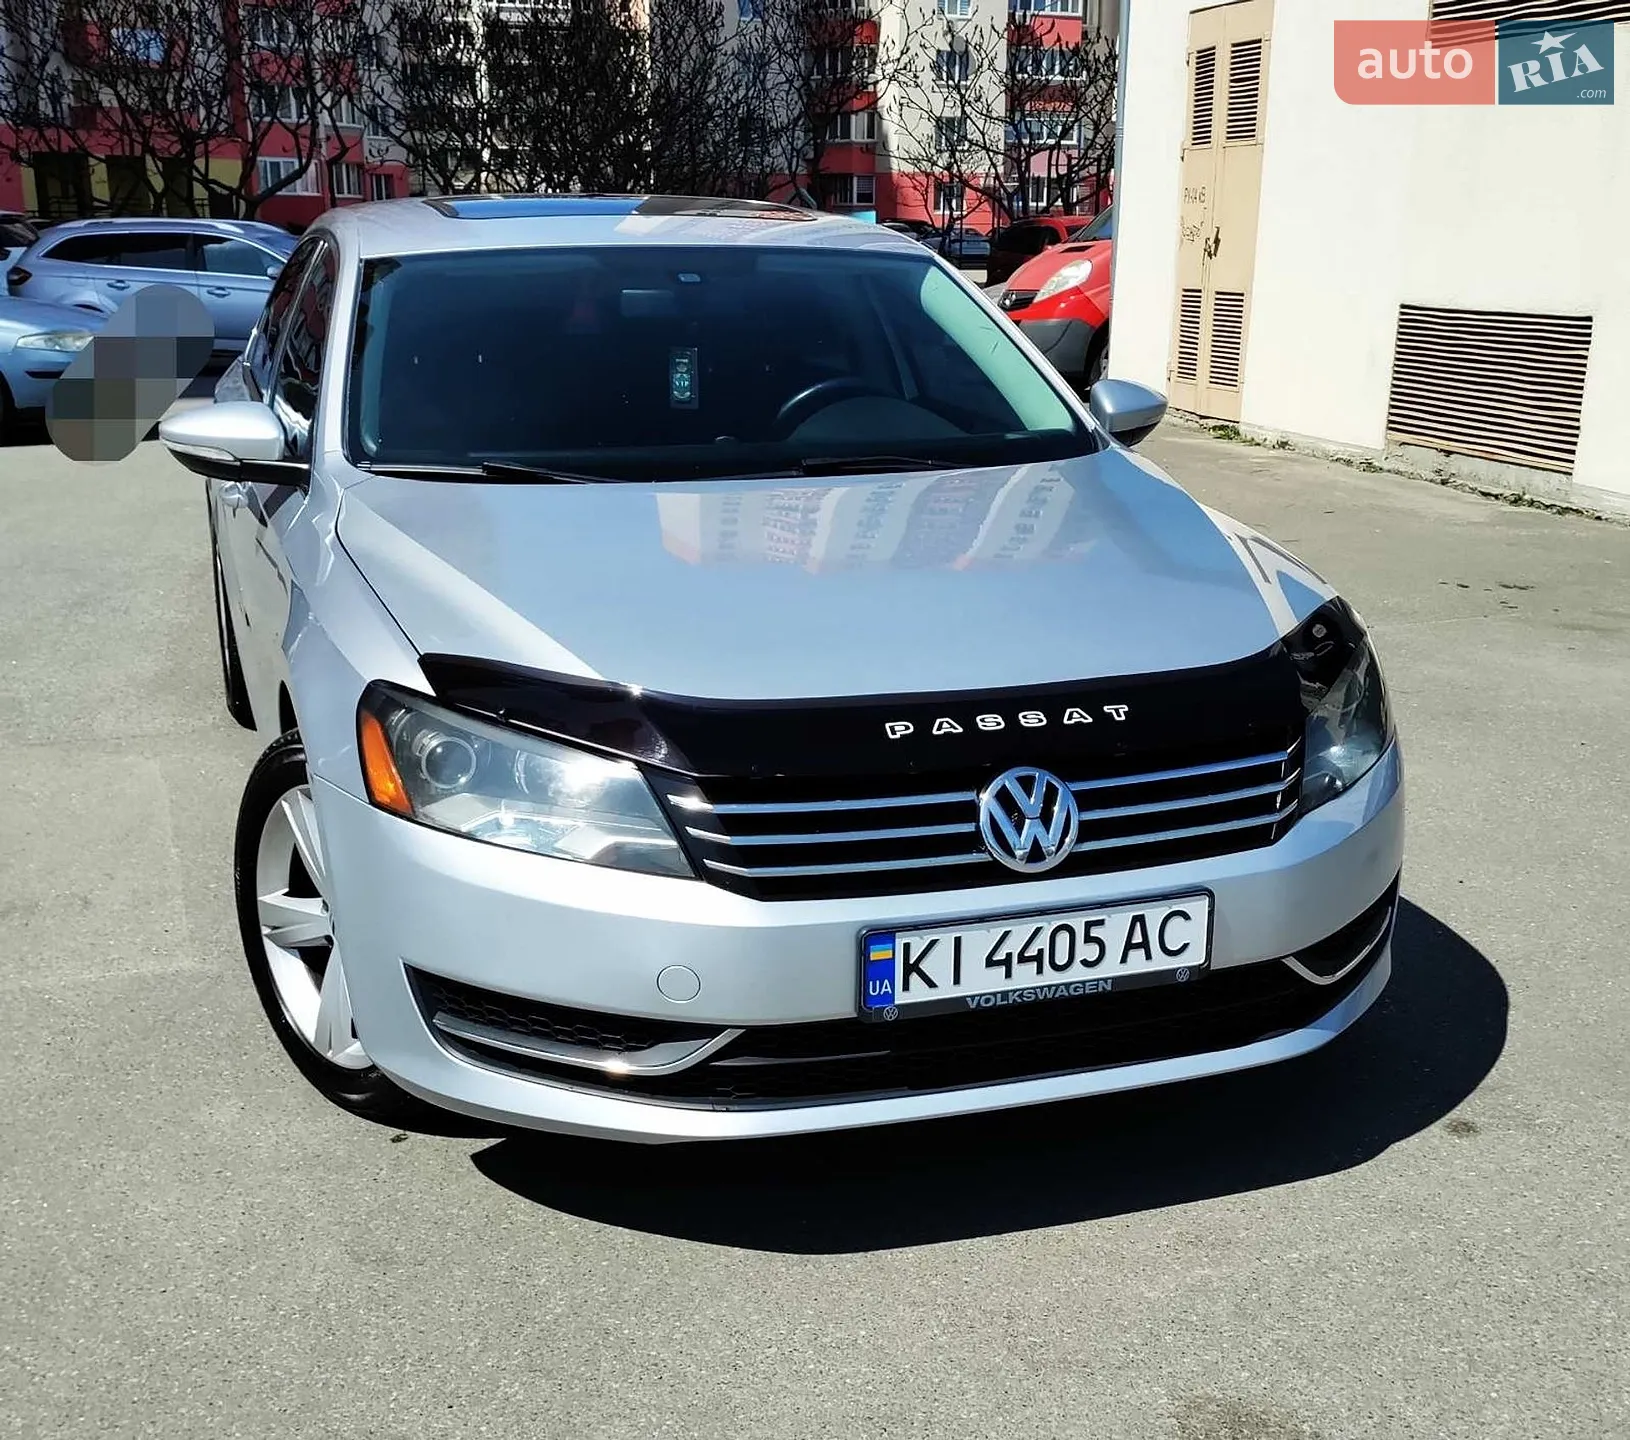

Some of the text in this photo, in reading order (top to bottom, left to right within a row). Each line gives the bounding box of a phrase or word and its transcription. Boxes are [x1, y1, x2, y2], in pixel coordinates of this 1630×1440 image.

[884, 704, 1129, 739] PASSAT
[984, 917, 1107, 980] 4405
[1118, 908, 1193, 965] AC
[869, 979, 893, 996] UA
[965, 978, 1114, 1010] VOLKSWAGEN
